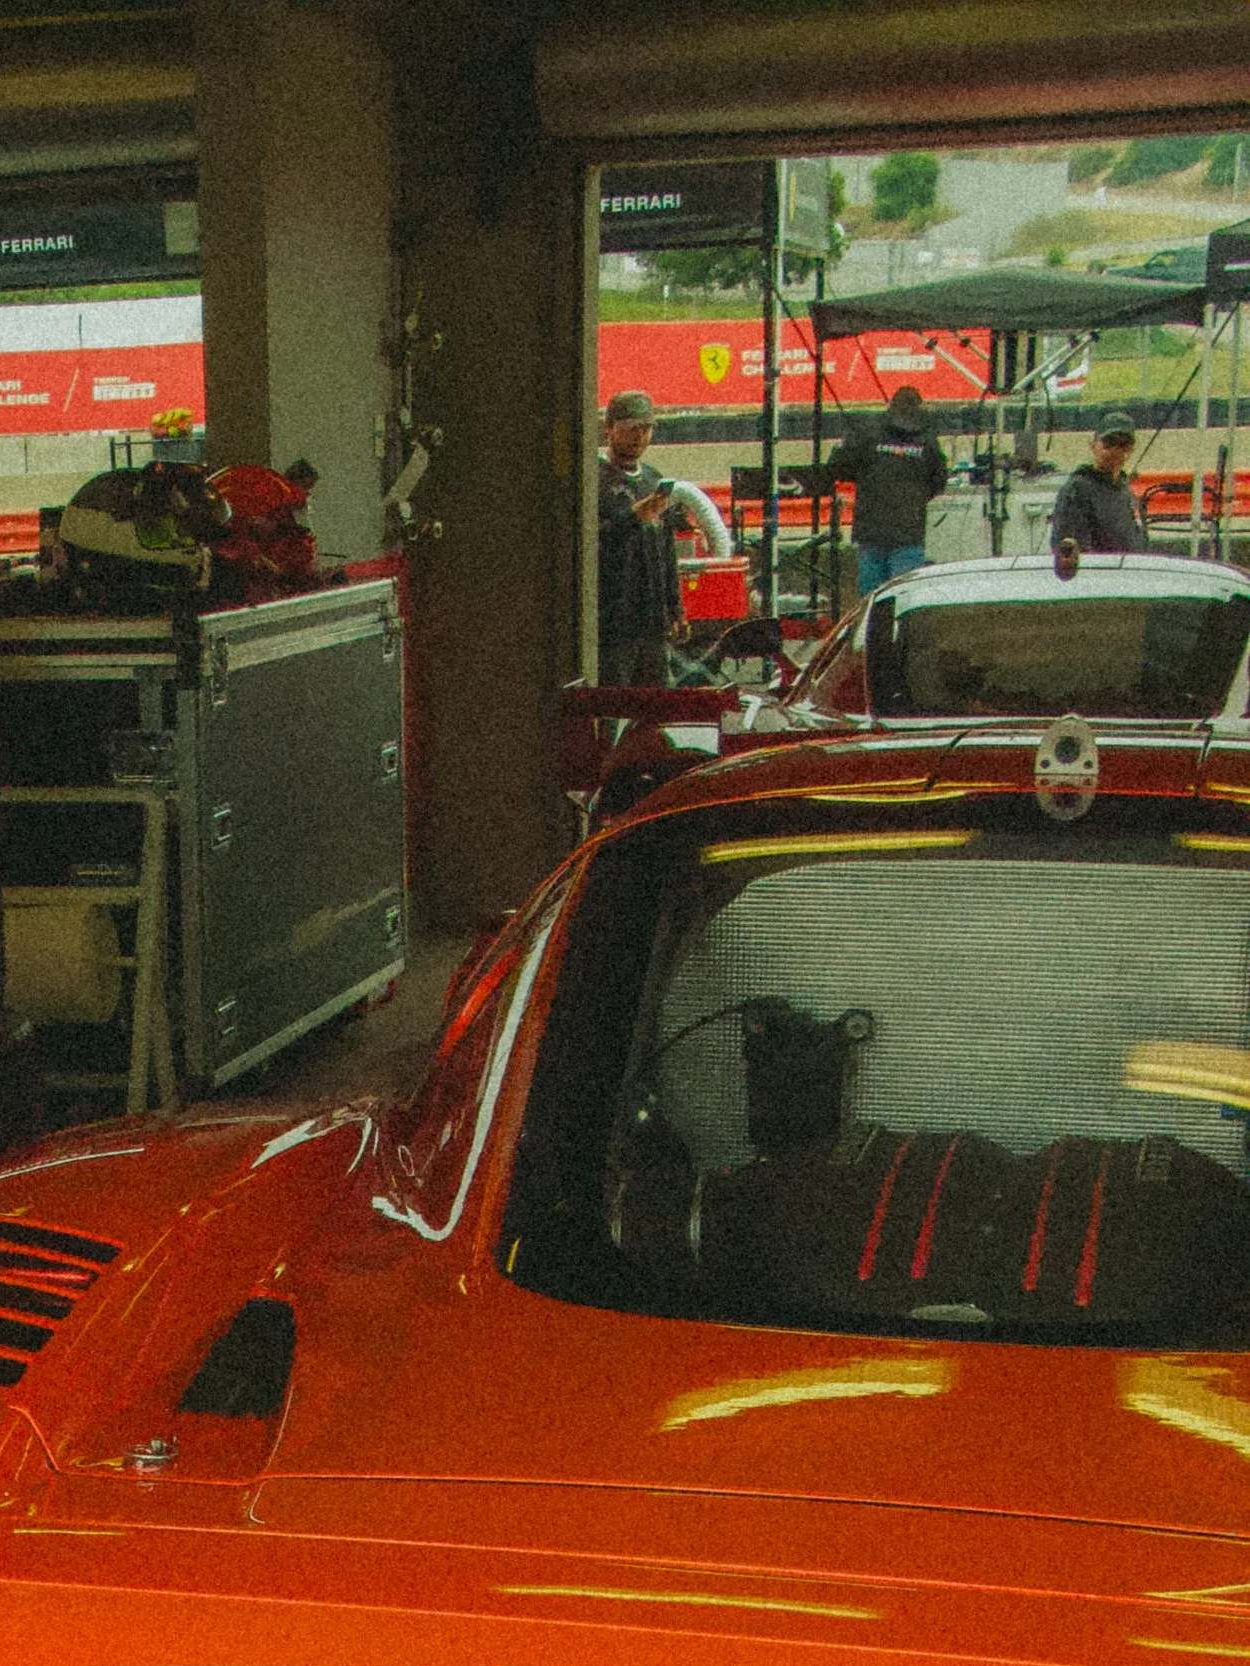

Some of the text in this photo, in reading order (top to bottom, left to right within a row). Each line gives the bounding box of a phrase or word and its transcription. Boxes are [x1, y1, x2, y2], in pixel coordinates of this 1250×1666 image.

[600, 193, 681, 213] FERRARI
[0, 234, 74, 254] FERRARI
[741, 349, 810, 361] FEARI
